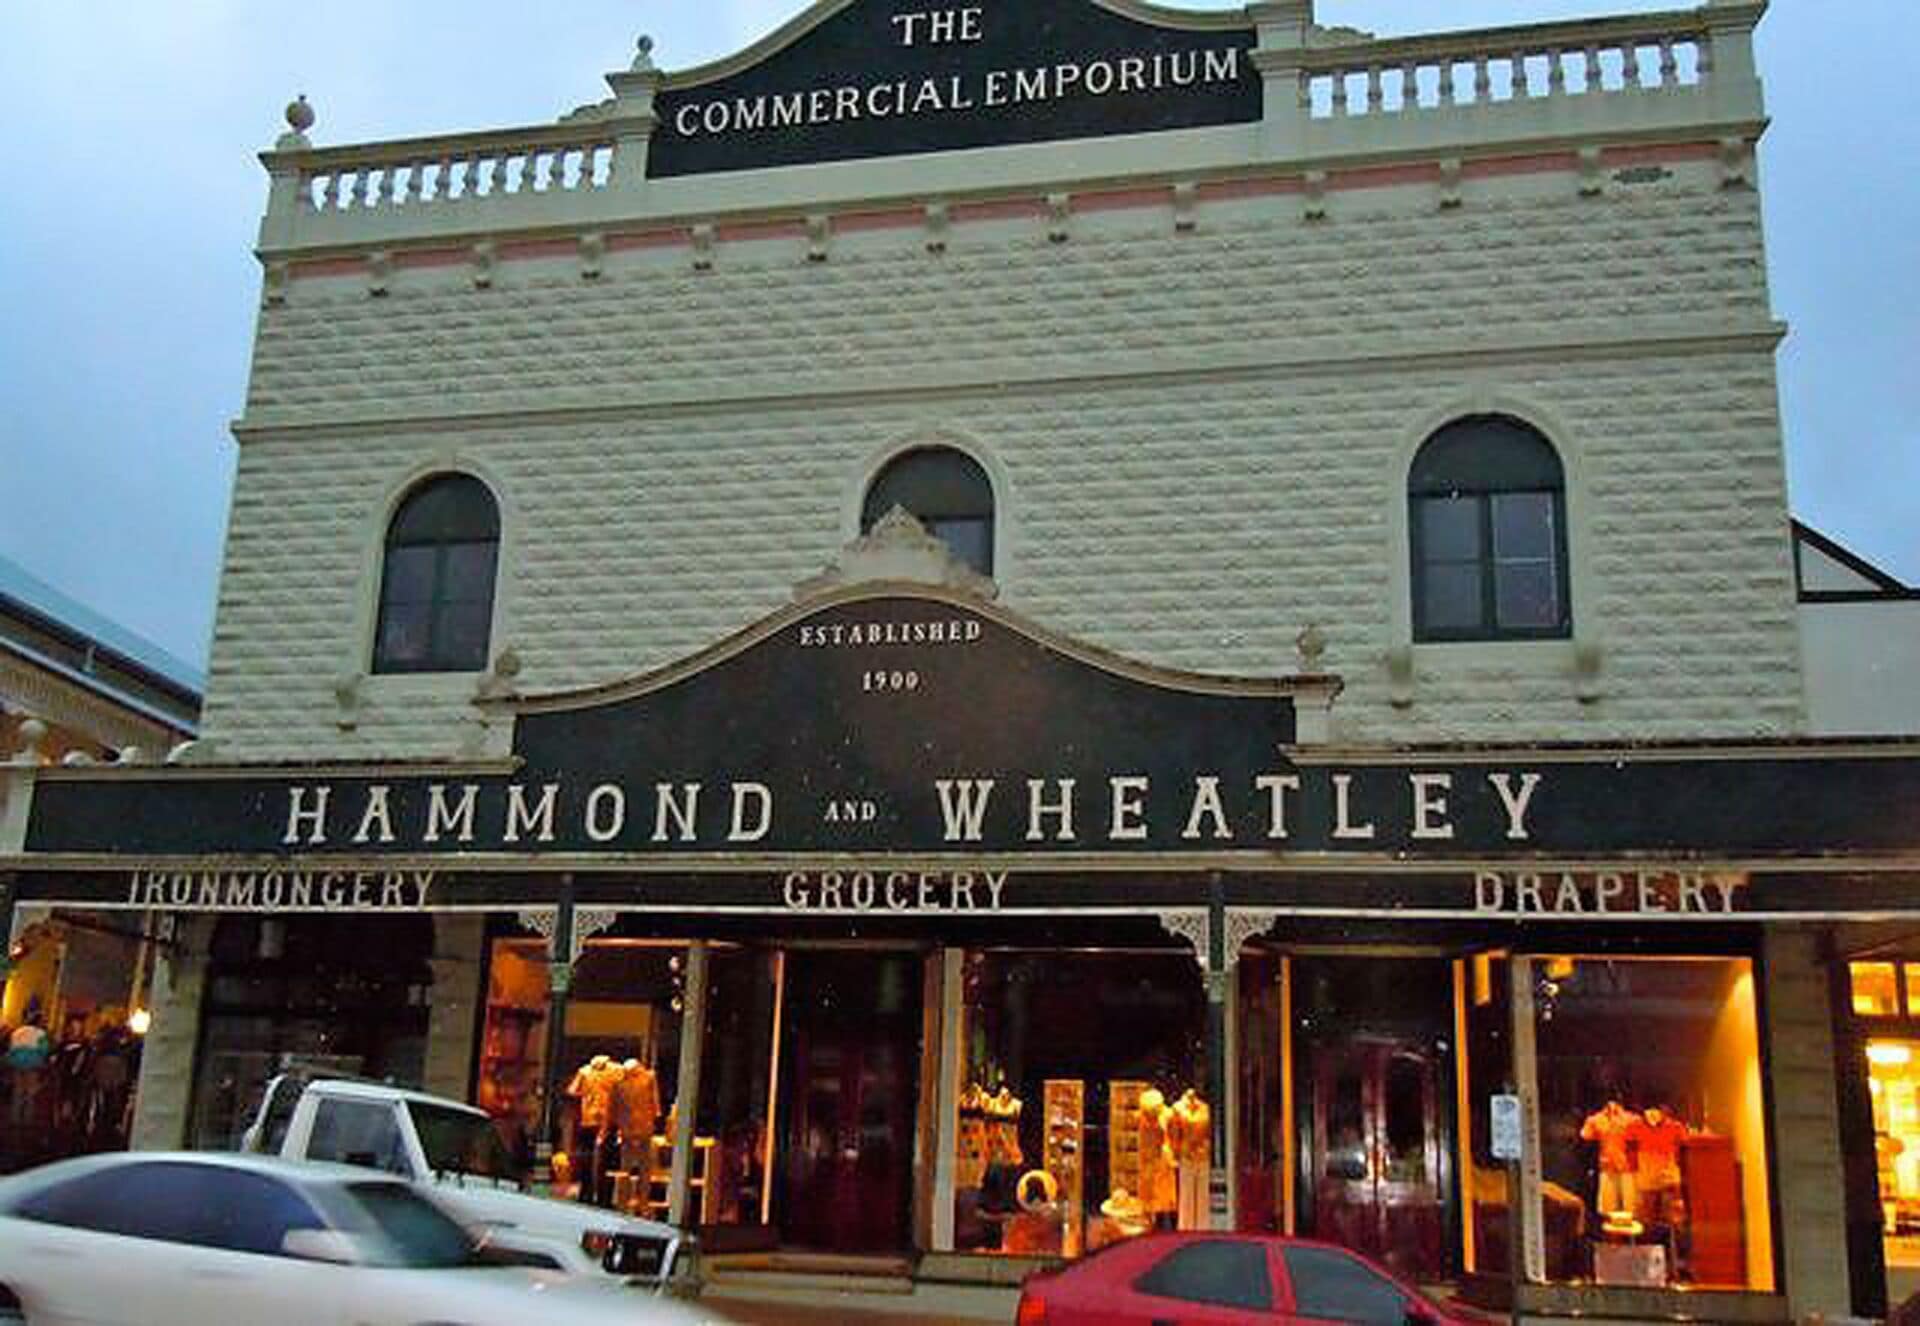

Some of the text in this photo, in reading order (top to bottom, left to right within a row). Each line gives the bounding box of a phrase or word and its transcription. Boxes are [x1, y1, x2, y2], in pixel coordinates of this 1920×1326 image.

[892, 8, 982, 46] THE
[675, 47, 1238, 136] COMMERCIAL EMPORIUM
[801, 620, 981, 646] ESTABLISHED
[863, 671, 919, 691] 1900
[283, 772, 1541, 844] HAMMOND AND WHEATLEY
[128, 870, 433, 909] IRONMONGERY
[784, 870, 1008, 910] GROCERY
[1475, 871, 1748, 913] DRAPERY
